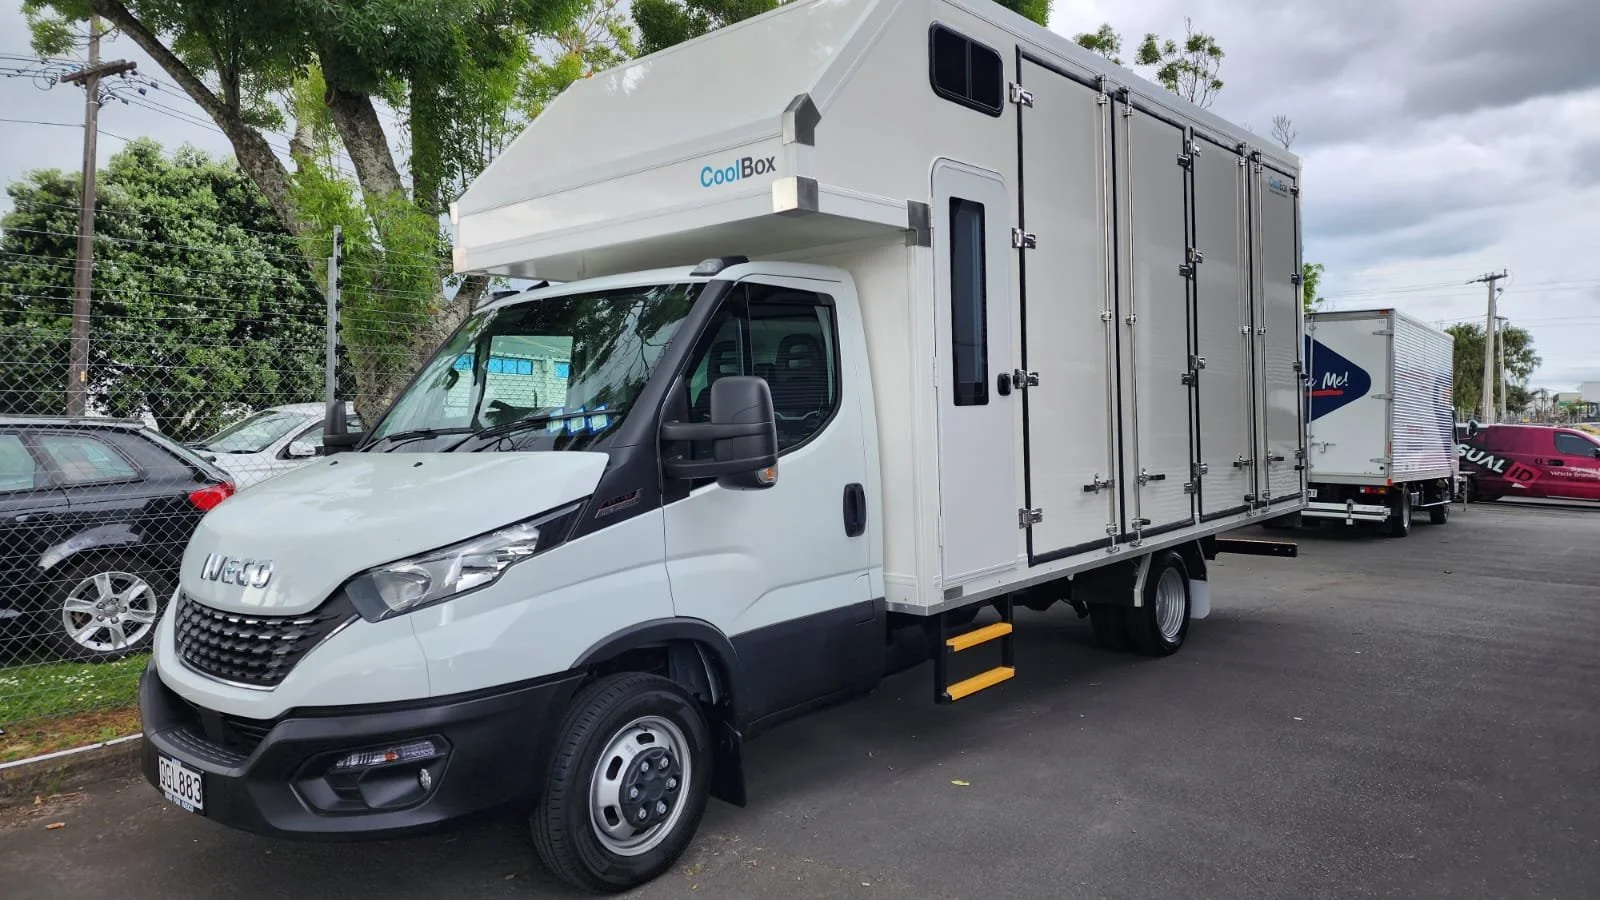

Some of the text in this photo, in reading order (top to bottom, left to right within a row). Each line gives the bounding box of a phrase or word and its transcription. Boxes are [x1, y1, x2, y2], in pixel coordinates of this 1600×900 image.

[700, 156, 776, 187] CoolBox
[1322, 371, 1349, 390] Me!
[1509, 466, 1534, 481] ID
[200, 553, 273, 589] IVECO
